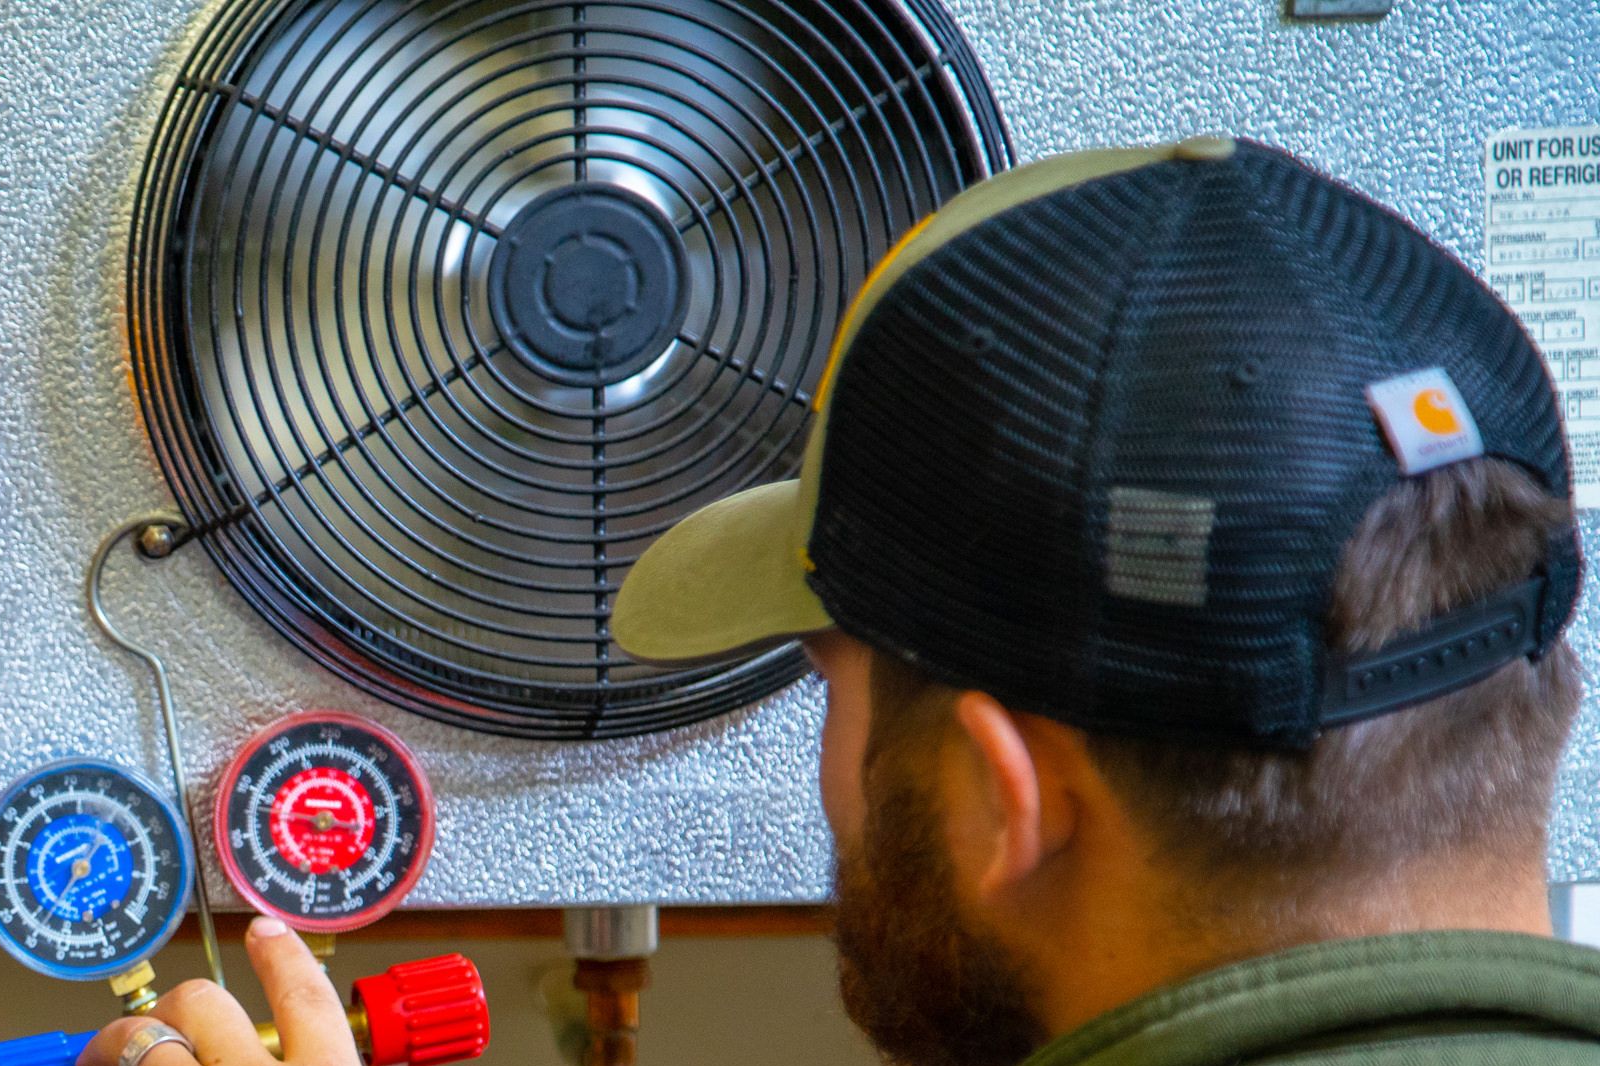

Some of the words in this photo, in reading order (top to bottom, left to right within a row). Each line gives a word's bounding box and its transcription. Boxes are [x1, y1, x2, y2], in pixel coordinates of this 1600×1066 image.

[1493, 139, 1534, 161] UNIT
[1538, 137, 1574, 158] FOR
[1497, 168, 1522, 189] OR
[342, 894, 364, 912] 500
